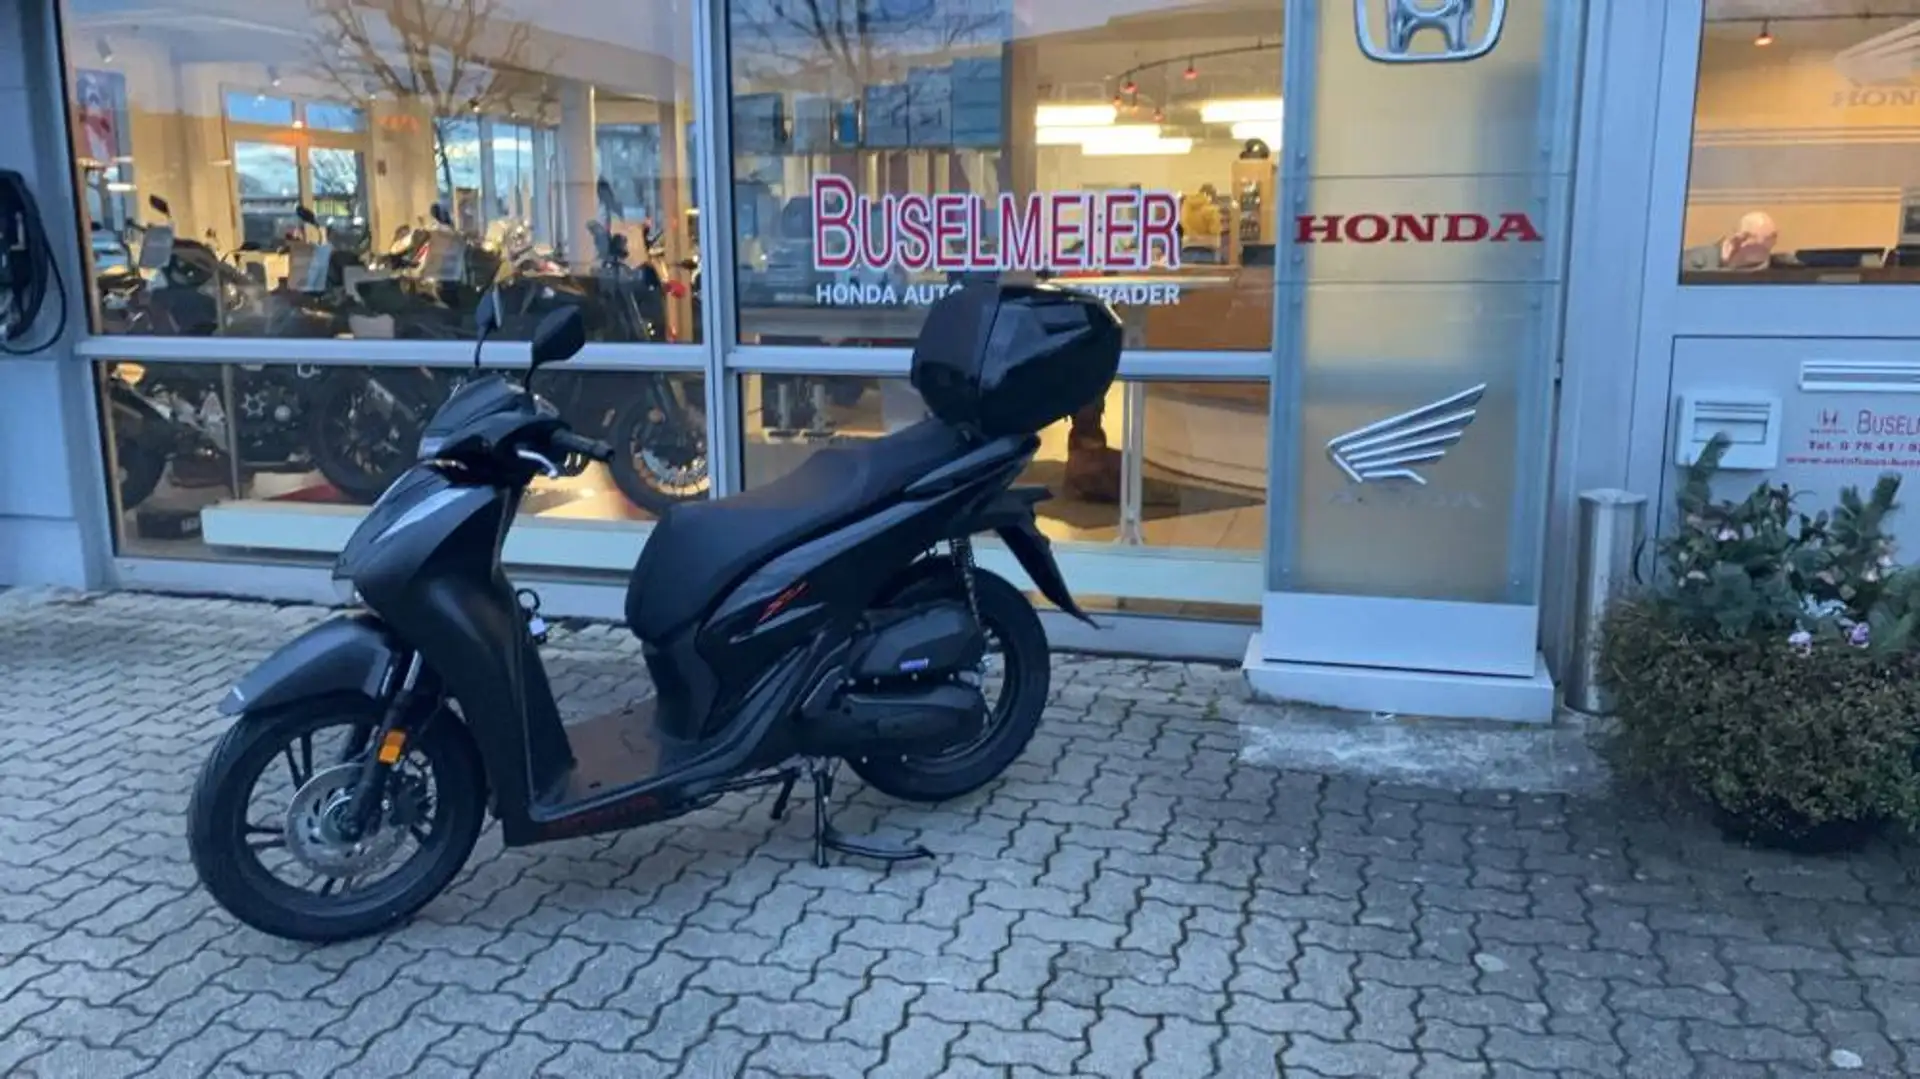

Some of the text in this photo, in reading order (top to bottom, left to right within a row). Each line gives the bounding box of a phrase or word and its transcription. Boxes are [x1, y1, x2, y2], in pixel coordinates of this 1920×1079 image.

[813, 174, 1181, 271] BUSELMEIER
[1293, 213, 1545, 244] HONDA
[815, 284, 897, 305] HONDA
[1856, 408, 1920, 436] BUSEL
